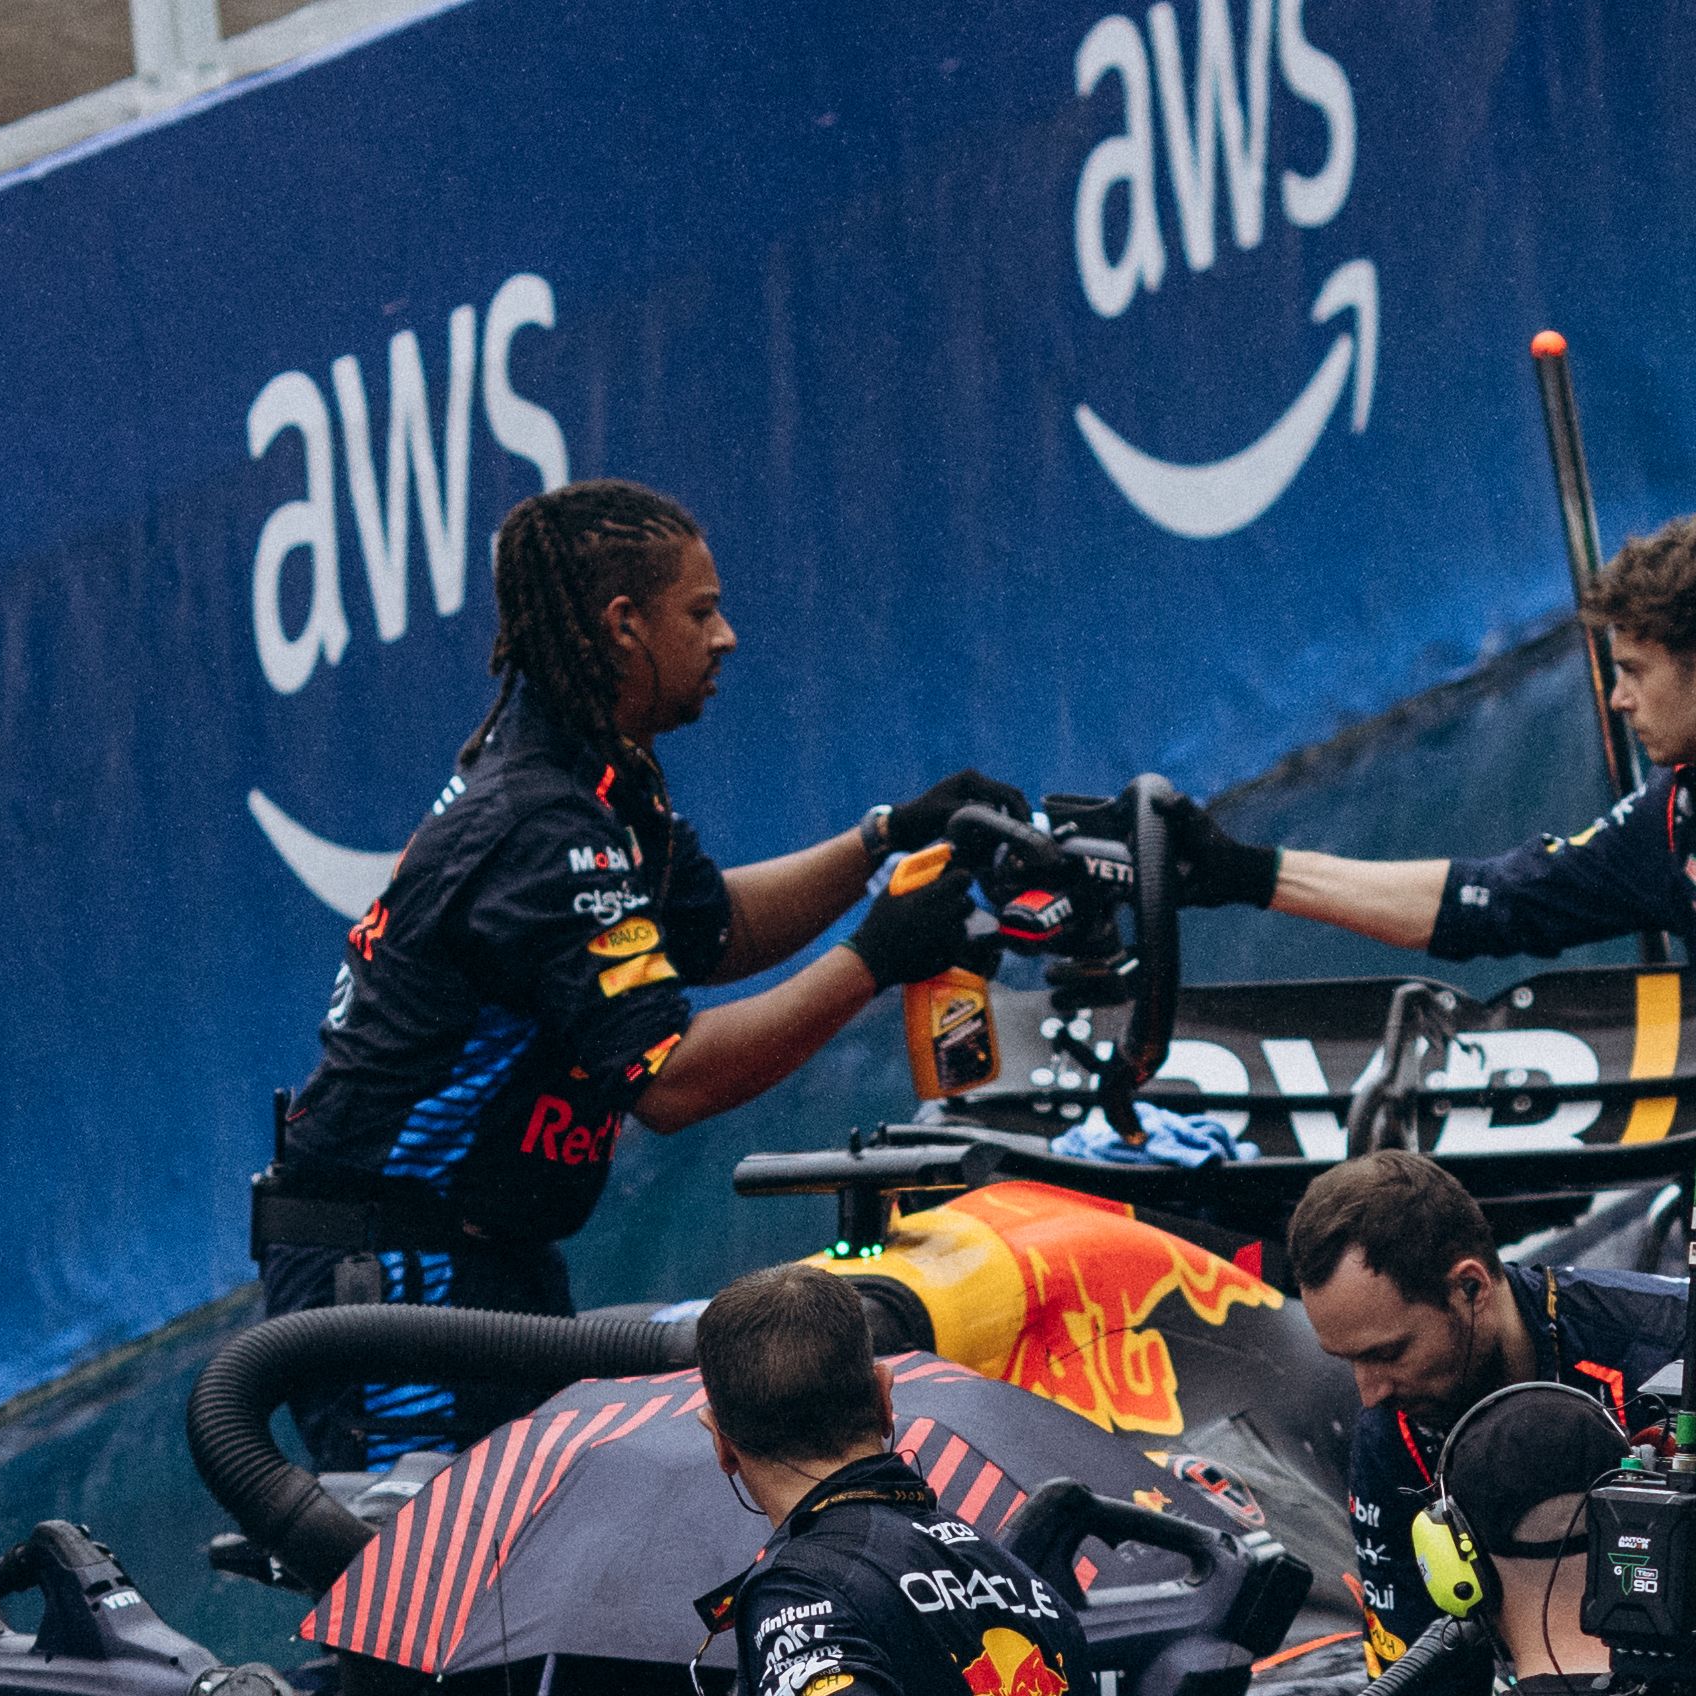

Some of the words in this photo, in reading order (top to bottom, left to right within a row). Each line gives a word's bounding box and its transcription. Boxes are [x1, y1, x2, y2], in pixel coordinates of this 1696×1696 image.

[1074, 0, 1357, 318] aws
[1085, 856, 1134, 884] YETI
[1349, 1494, 1381, 1528] bil
[1363, 1580, 1395, 1611] Sui
